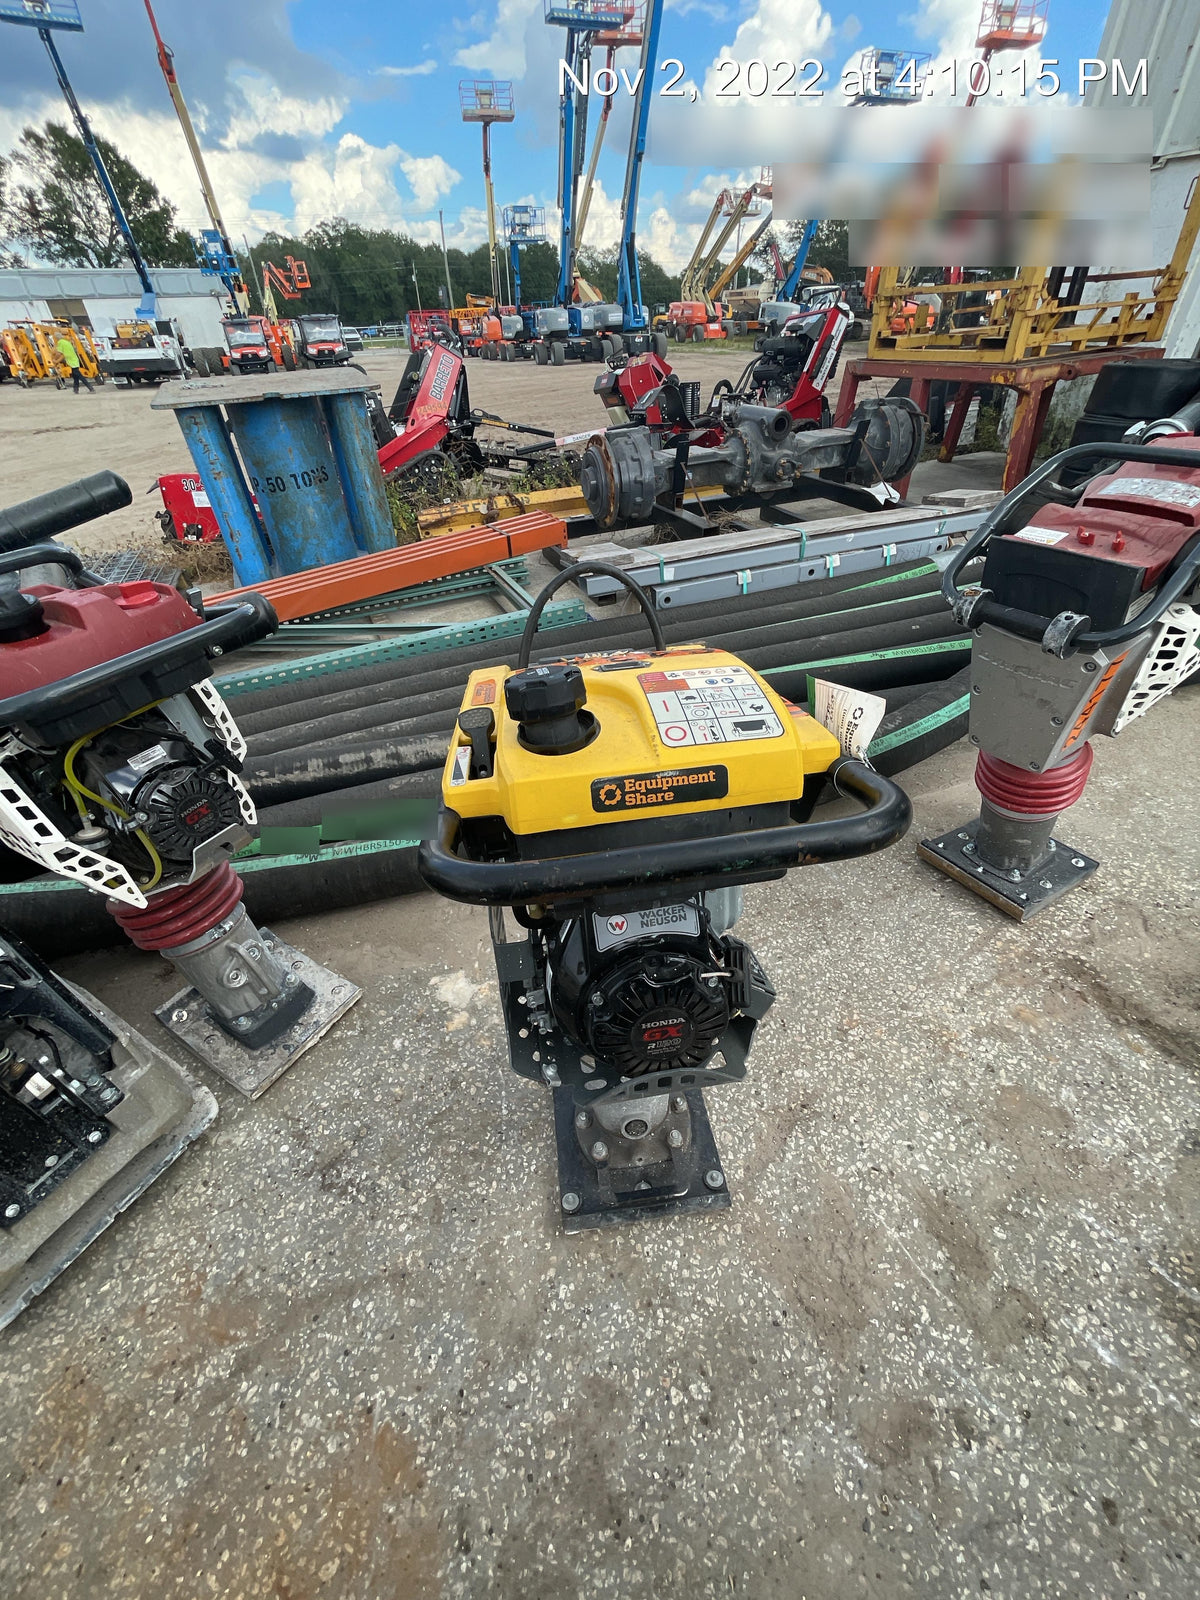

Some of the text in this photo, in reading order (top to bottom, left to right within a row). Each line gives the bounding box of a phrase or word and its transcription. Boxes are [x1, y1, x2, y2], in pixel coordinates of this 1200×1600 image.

[429, 353, 454, 401] BARRETO
[266, 476, 286, 492] 50
[624, 770, 716, 792] Equipment
[625, 791, 674, 806] Share
[180, 798, 208, 818] HONDA
[186, 803, 212, 825] GX
[638, 904, 686, 920] WACKER
[640, 913, 688, 928] NEUSON
[641, 1018, 686, 1029] HONDA
[643, 1024, 684, 1042] GX
